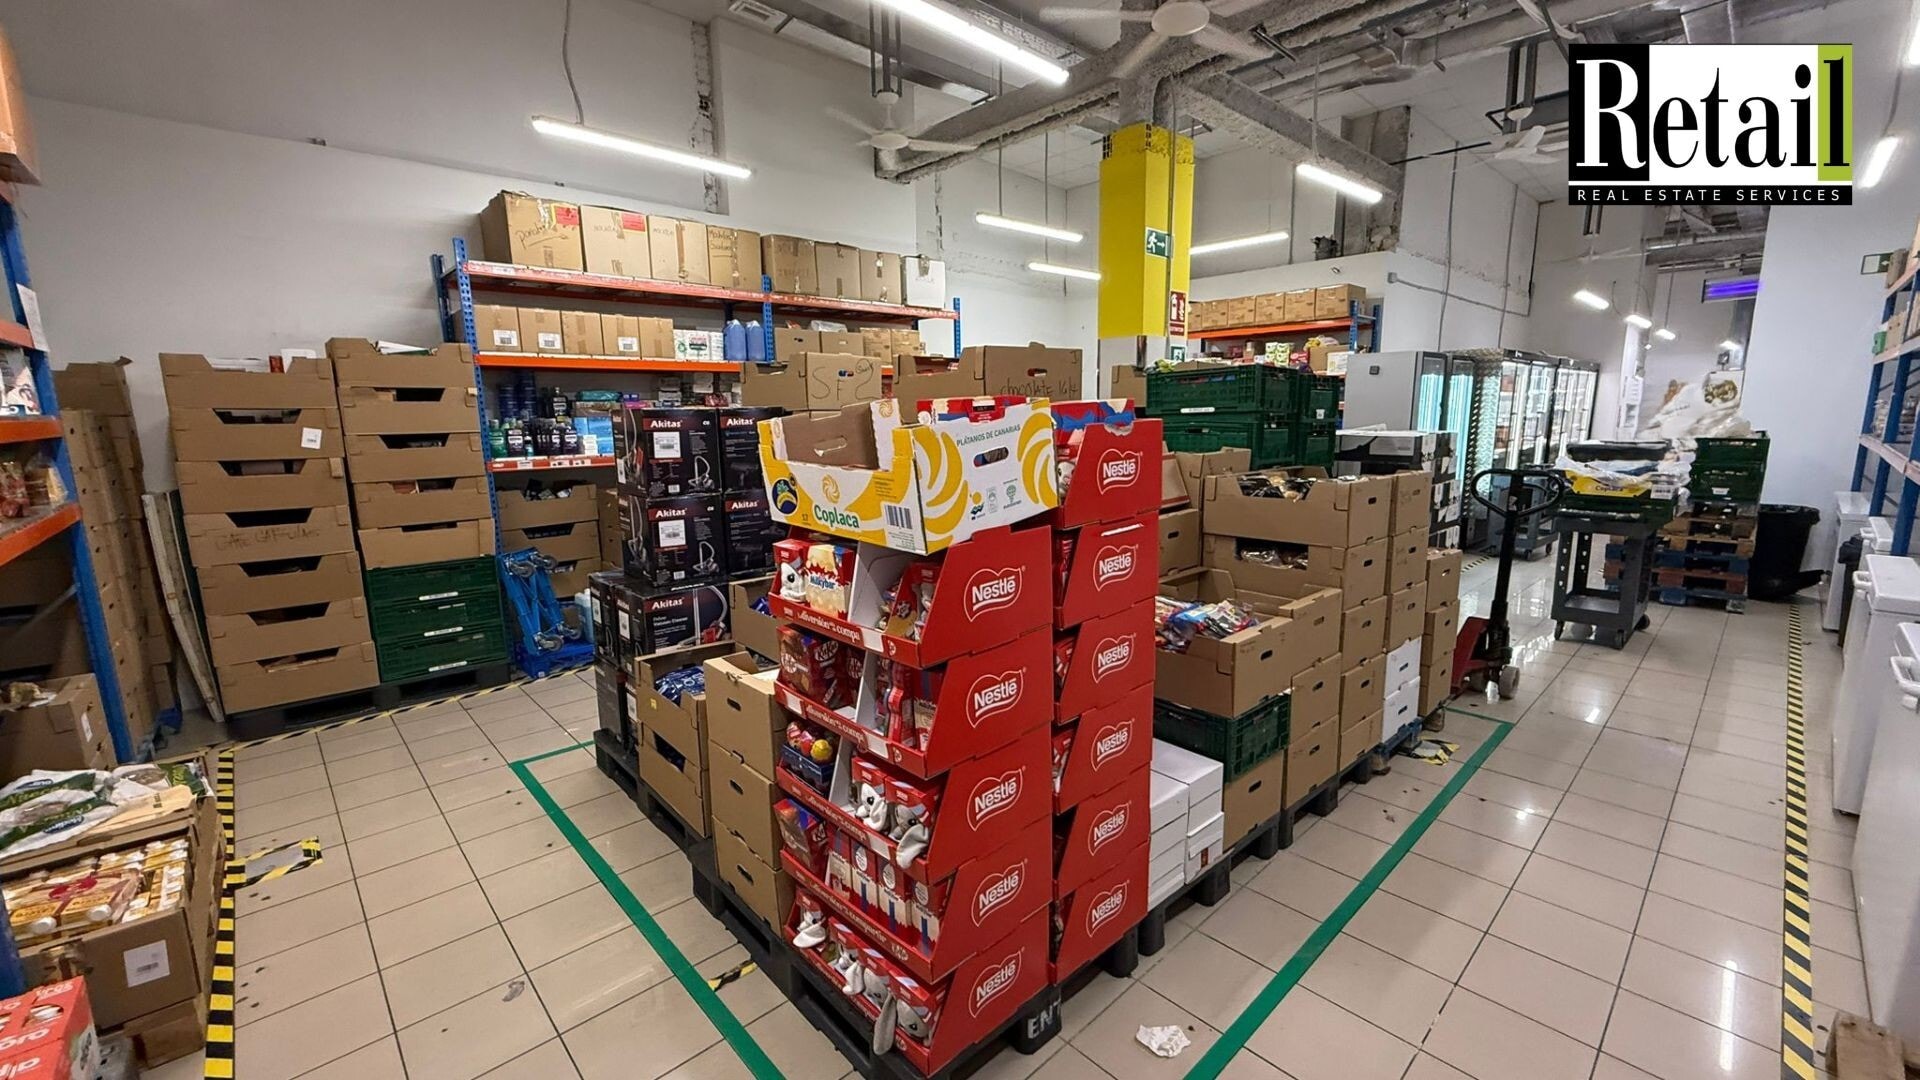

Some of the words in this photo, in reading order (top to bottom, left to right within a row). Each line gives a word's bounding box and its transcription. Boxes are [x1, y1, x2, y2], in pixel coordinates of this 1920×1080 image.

[650, 418, 682, 429] Akitas
[726, 418, 754, 426] Akitas
[956, 431, 986, 446] PLÁTANOS
[985, 429, 994, 439] DE
[994, 423, 1021, 438] CANARIAS
[1103, 459, 1137, 478] Nestlé
[655, 508, 687, 519] Akitas
[732, 501, 758, 510] Akitas
[813, 504, 860, 529] Coplaca
[1099, 552, 1132, 576] Nestlé
[810, 575, 836, 589] Milkybar
[971, 574, 1017, 603] Nestlé
[651, 598, 684, 610] Akitas
[1097, 642, 1131, 667] Nestlé
[974, 679, 1019, 708] Nestlé
[1096, 728, 1128, 754] Nestlé
[974, 778, 1018, 813] Nestlé
[1093, 810, 1126, 839] Nestlé
[979, 870, 1020, 909] Nestlé
[1092, 890, 1124, 922] Nestlé
[976, 962, 1017, 1002] Nestlé
